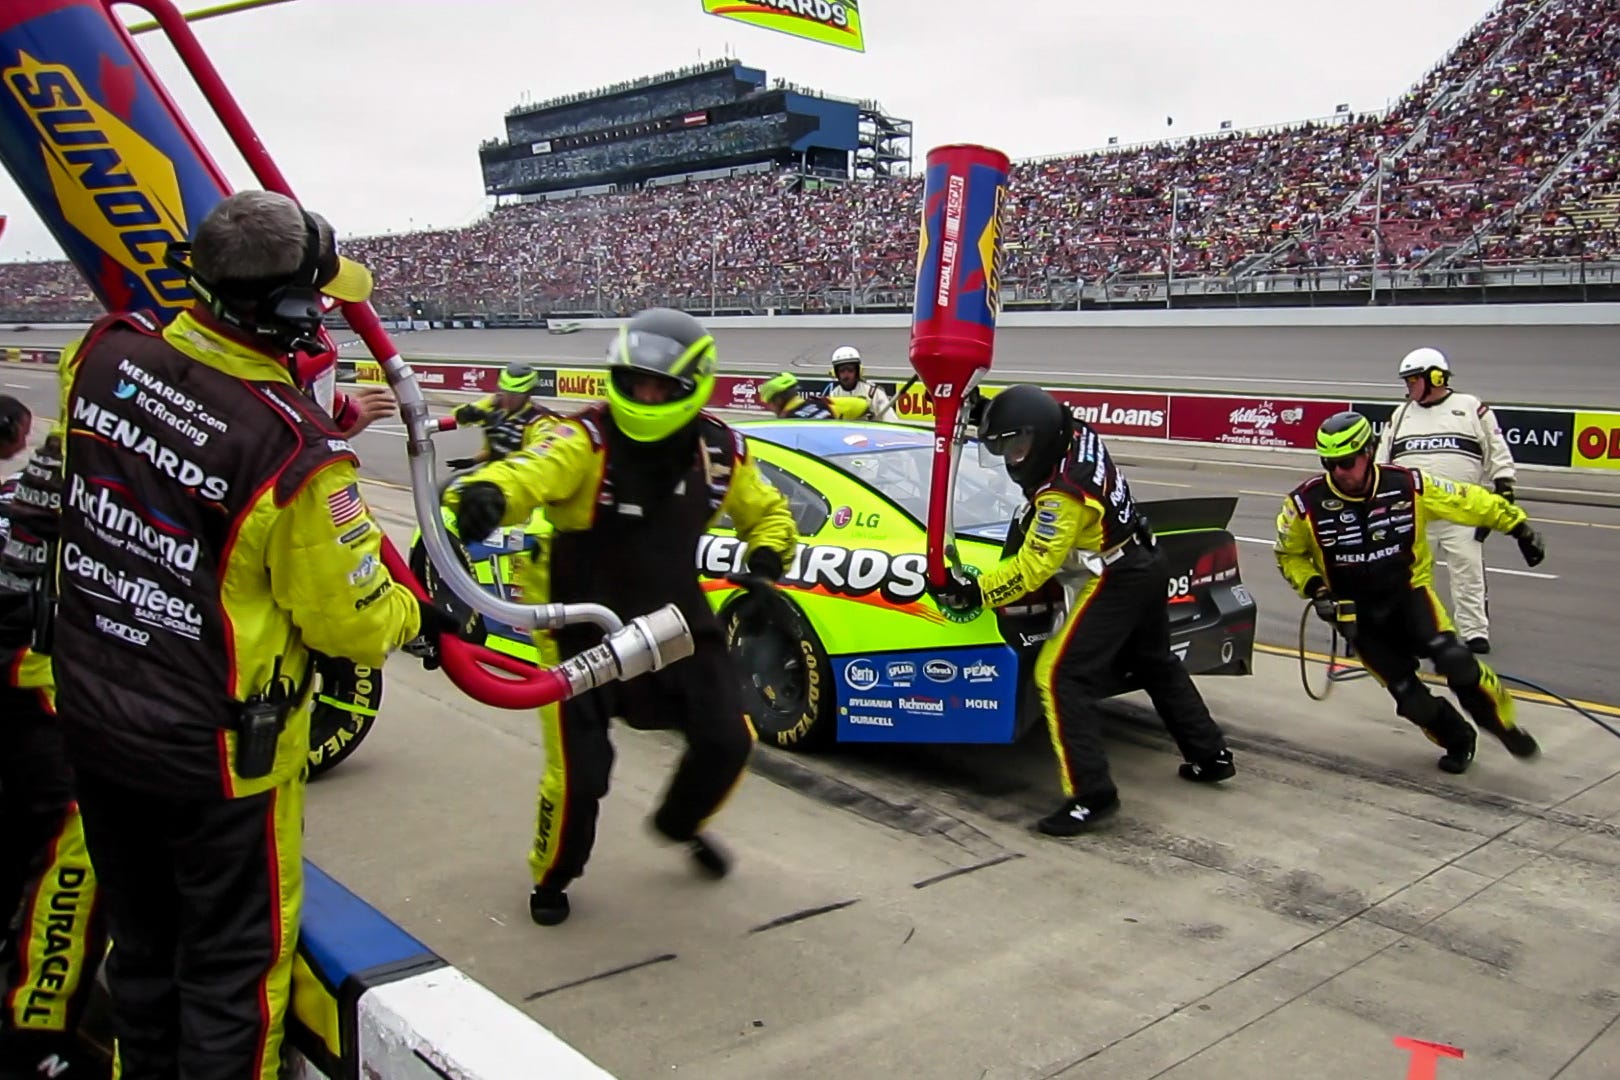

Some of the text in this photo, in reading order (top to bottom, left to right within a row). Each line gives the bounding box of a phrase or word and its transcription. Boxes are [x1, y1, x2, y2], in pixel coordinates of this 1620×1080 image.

[754, 0, 848, 26] ARDS
[11, 71, 196, 301] SUNOCO
[950, 175, 964, 220] NASCAR
[938, 264, 952, 307] OFFICIAL
[898, 392, 934, 416] OLL
[1100, 402, 1164, 427] Loans
[135, 391, 209, 447] RCRracing
[1229, 407, 1278, 429] Kellogg's
[73, 396, 229, 501] MENARDS
[1405, 437, 1460, 451] OFFICIAL
[1505, 427, 1560, 447] GAN
[1577, 426, 1620, 460] OL
[68, 473, 200, 572] Richmond
[855, 511, 880, 528] LG
[1335, 543, 1401, 562] MENARDS
[696, 534, 928, 598] ERDS
[96, 613, 150, 644] sparco
[851, 665, 874, 682] Serta
[963, 664, 999, 679] PEAK
[849, 698, 893, 709] SYLVANIA
[899, 697, 944, 712] Richmond
[965, 698, 998, 710] MOEN
[849, 715, 894, 727] DURACELL
[22, 867, 86, 1023] DURACELL
